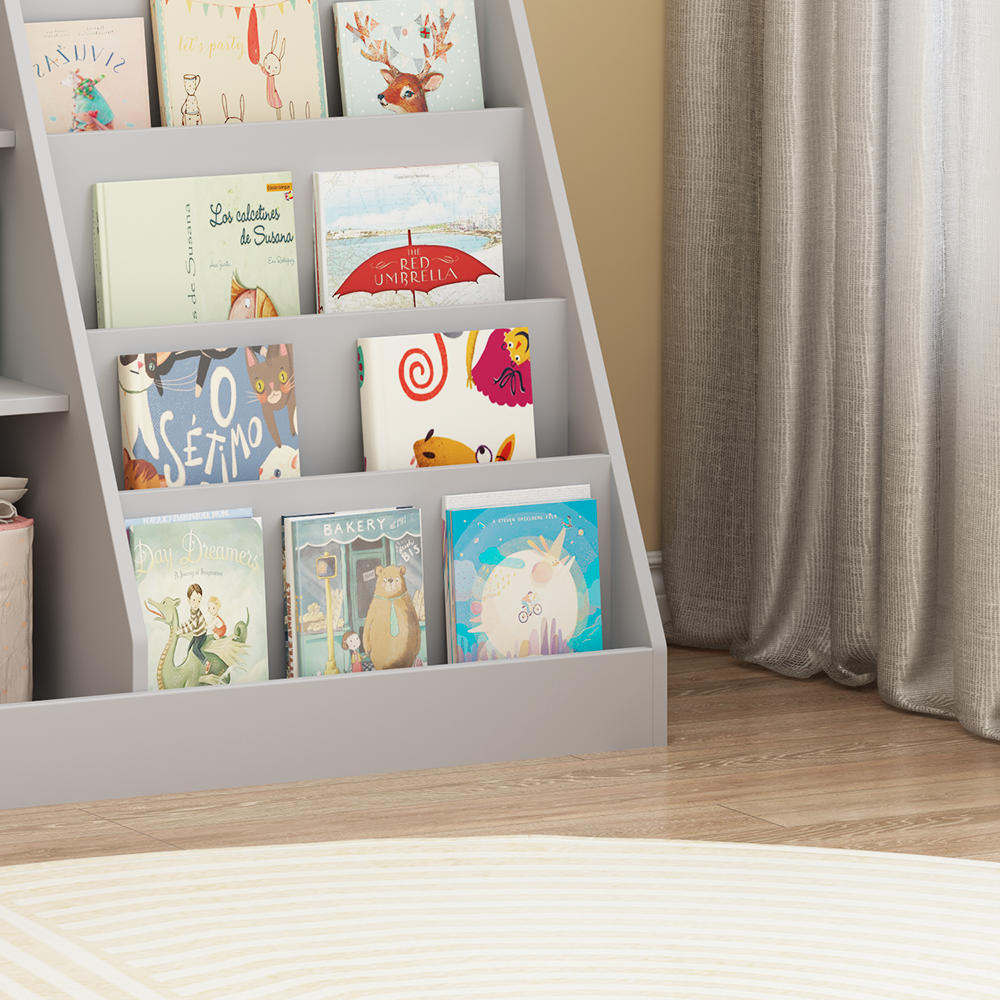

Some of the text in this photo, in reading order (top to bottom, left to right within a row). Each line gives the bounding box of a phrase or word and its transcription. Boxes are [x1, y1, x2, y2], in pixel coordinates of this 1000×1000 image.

[209, 35, 246, 60] party
[209, 202, 280, 228] Los calcetines
[185, 203, 197, 277] Susana
[240, 224, 294, 246] de Susana
[400, 256, 430, 271] RED
[407, 248, 421, 256] THE
[374, 267, 458, 286] UMBRELLA
[187, 282, 197, 305] de
[209, 366, 237, 428] O
[323, 517, 386, 537] BAKERY
[133, 527, 260, 579] Day Dreamers
